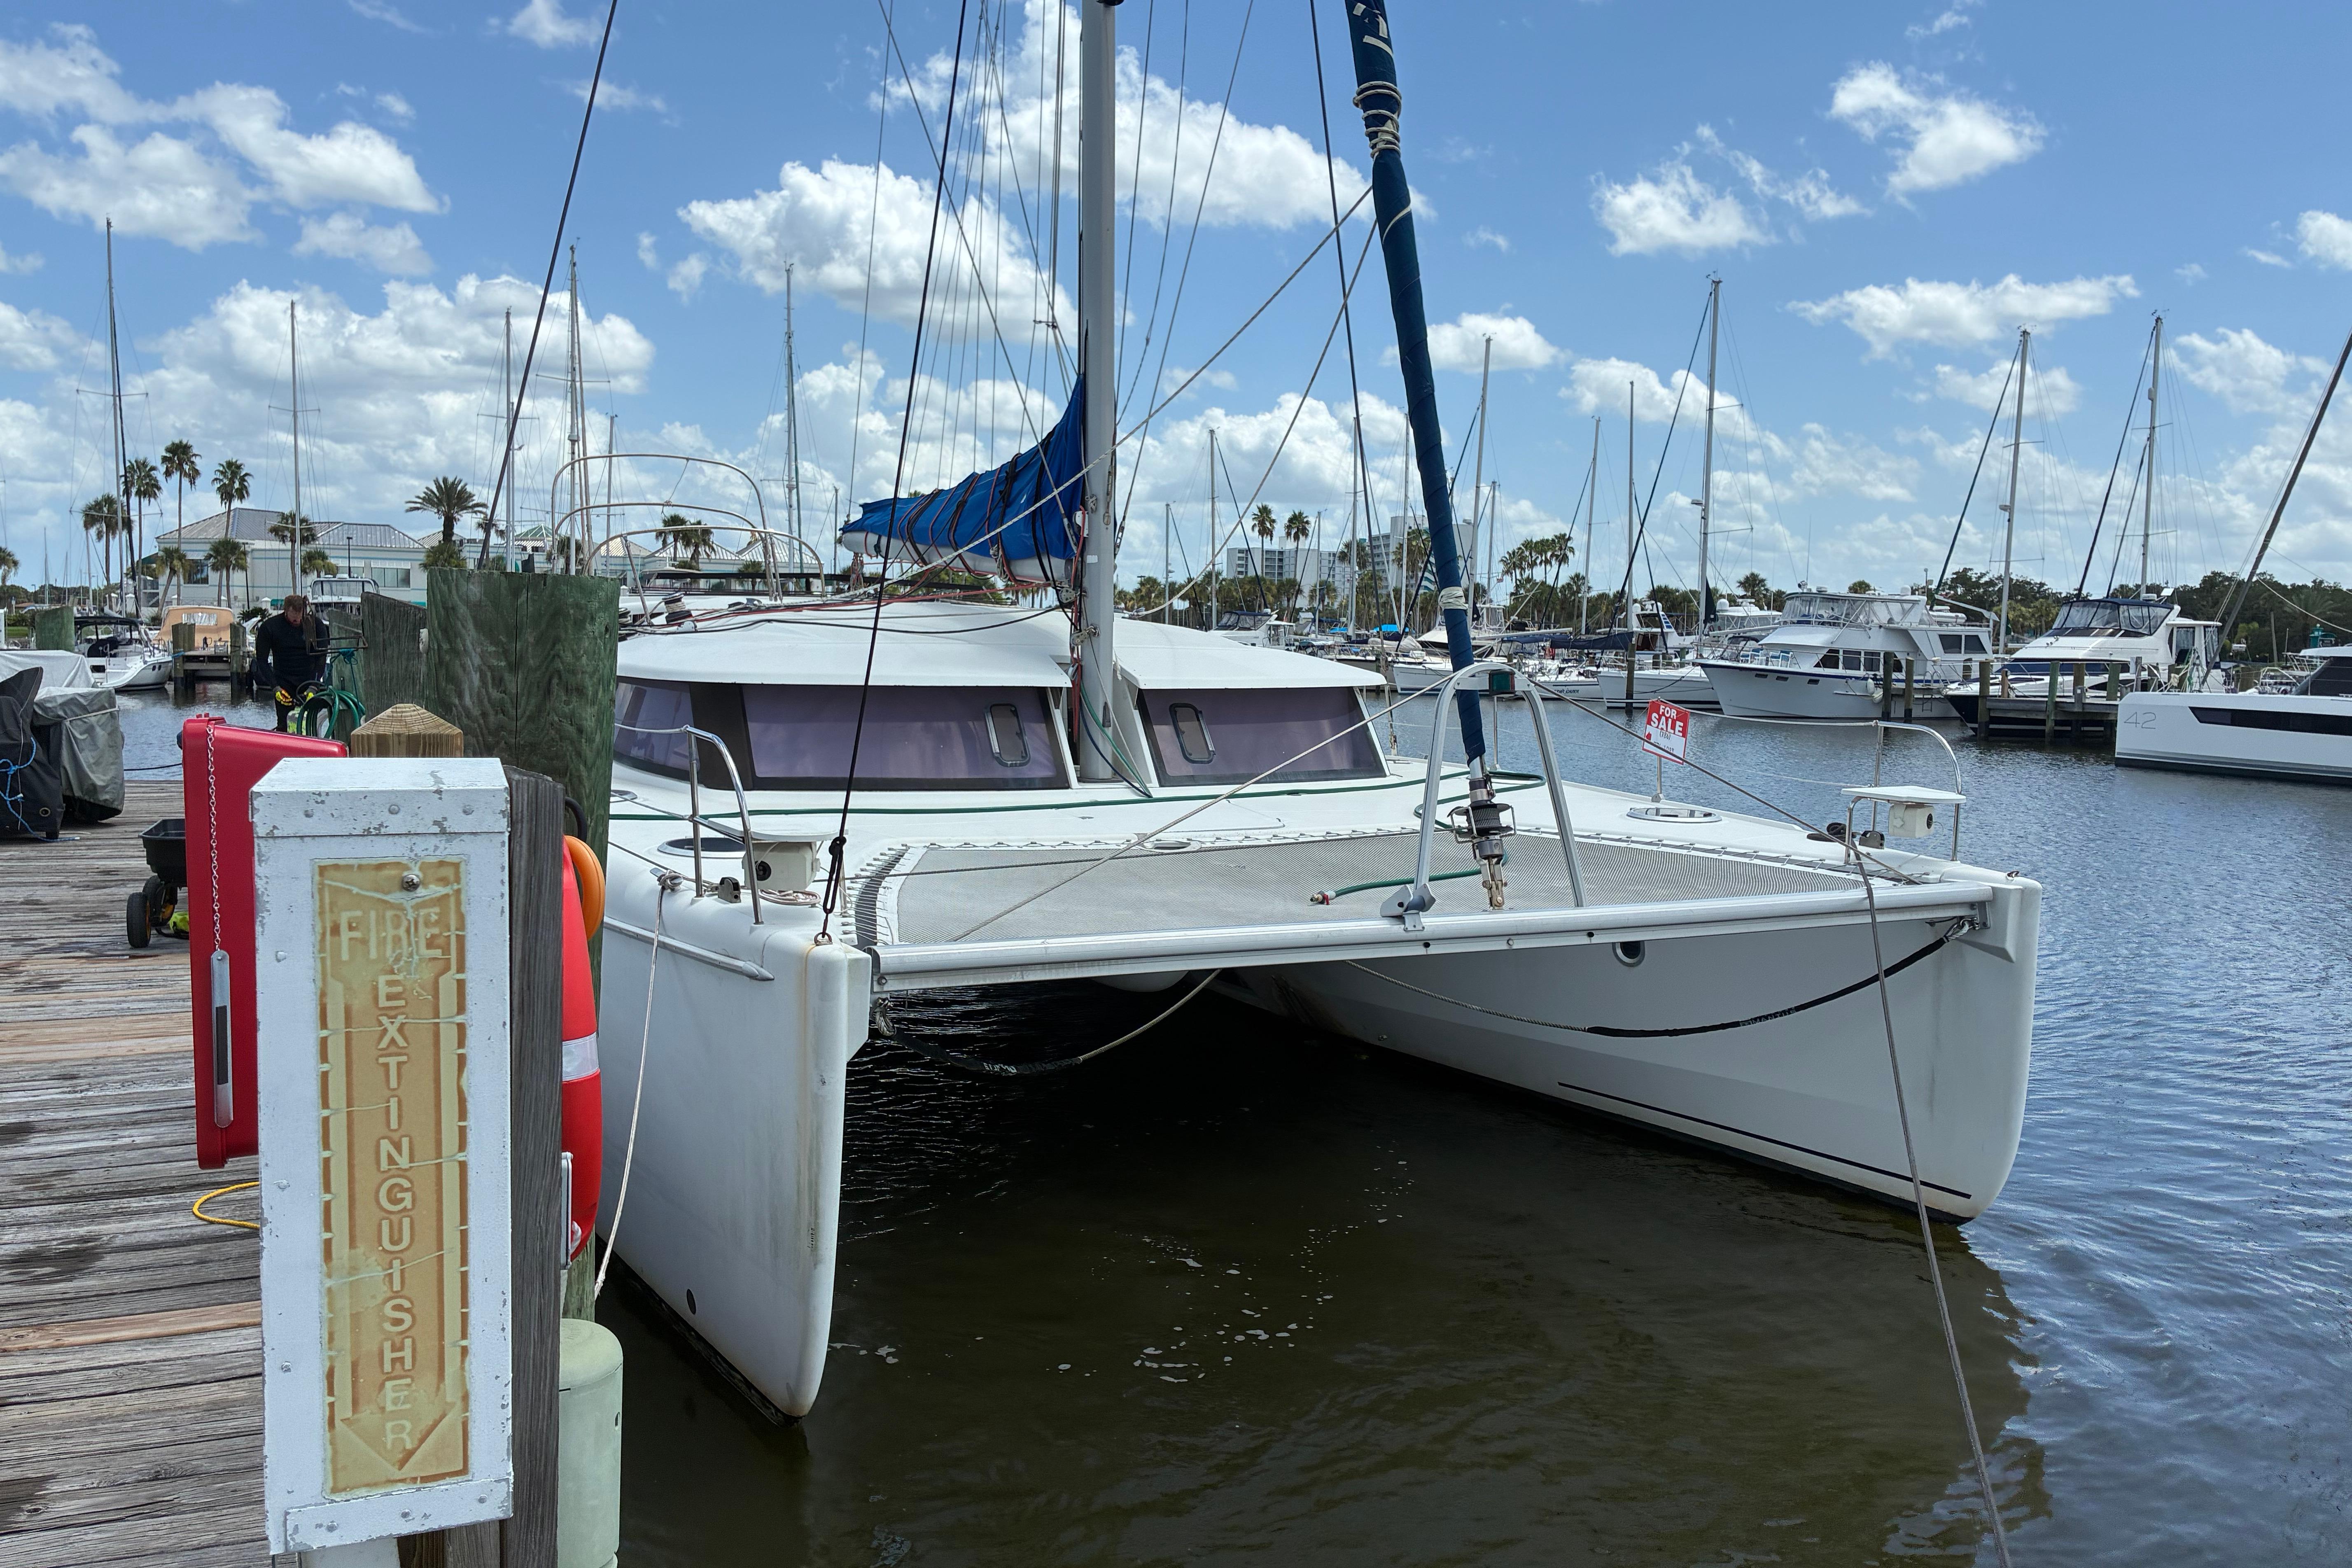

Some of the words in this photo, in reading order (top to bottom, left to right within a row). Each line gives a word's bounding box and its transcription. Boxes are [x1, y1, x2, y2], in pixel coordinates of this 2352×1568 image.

[1651, 712, 1683, 737] SALE
[1659, 705, 1677, 720] FOR
[2123, 712, 2156, 729] 42
[340, 907, 443, 961] FIRE
[377, 975, 413, 1450] EXTINGUISHER
